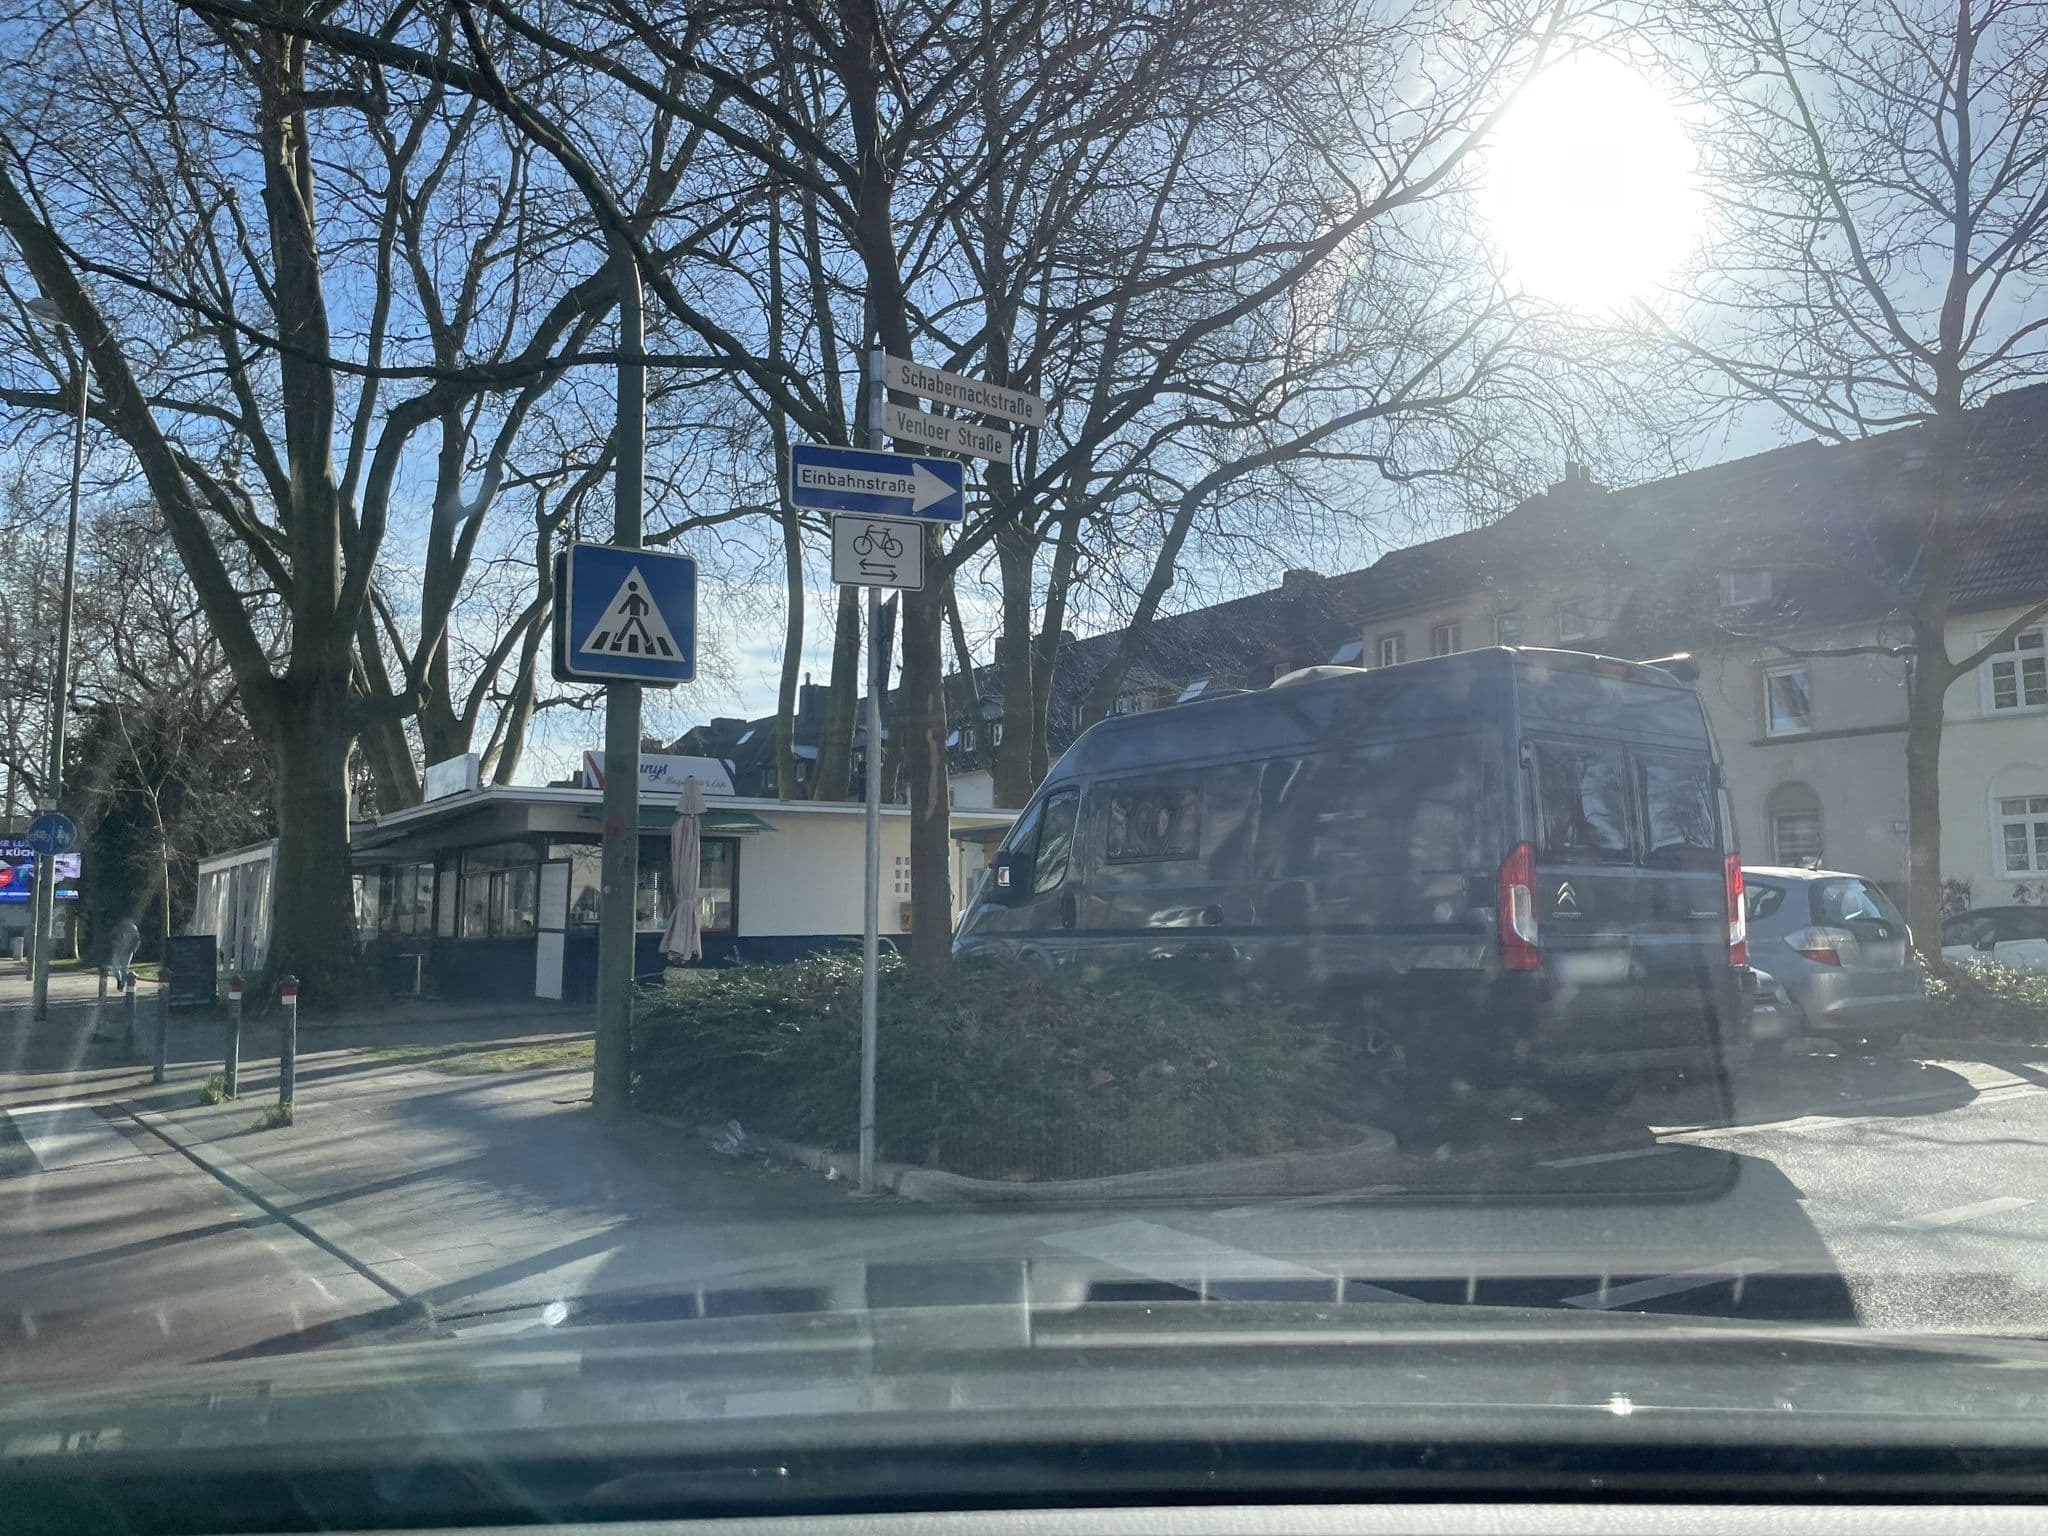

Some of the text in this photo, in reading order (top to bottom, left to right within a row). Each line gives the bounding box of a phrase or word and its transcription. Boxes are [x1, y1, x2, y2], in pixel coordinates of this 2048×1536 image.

[901, 365, 1033, 418] Schabernackstraße
[897, 410, 1003, 455] Venloer Straße
[801, 469, 916, 494] Einbahnstraße
